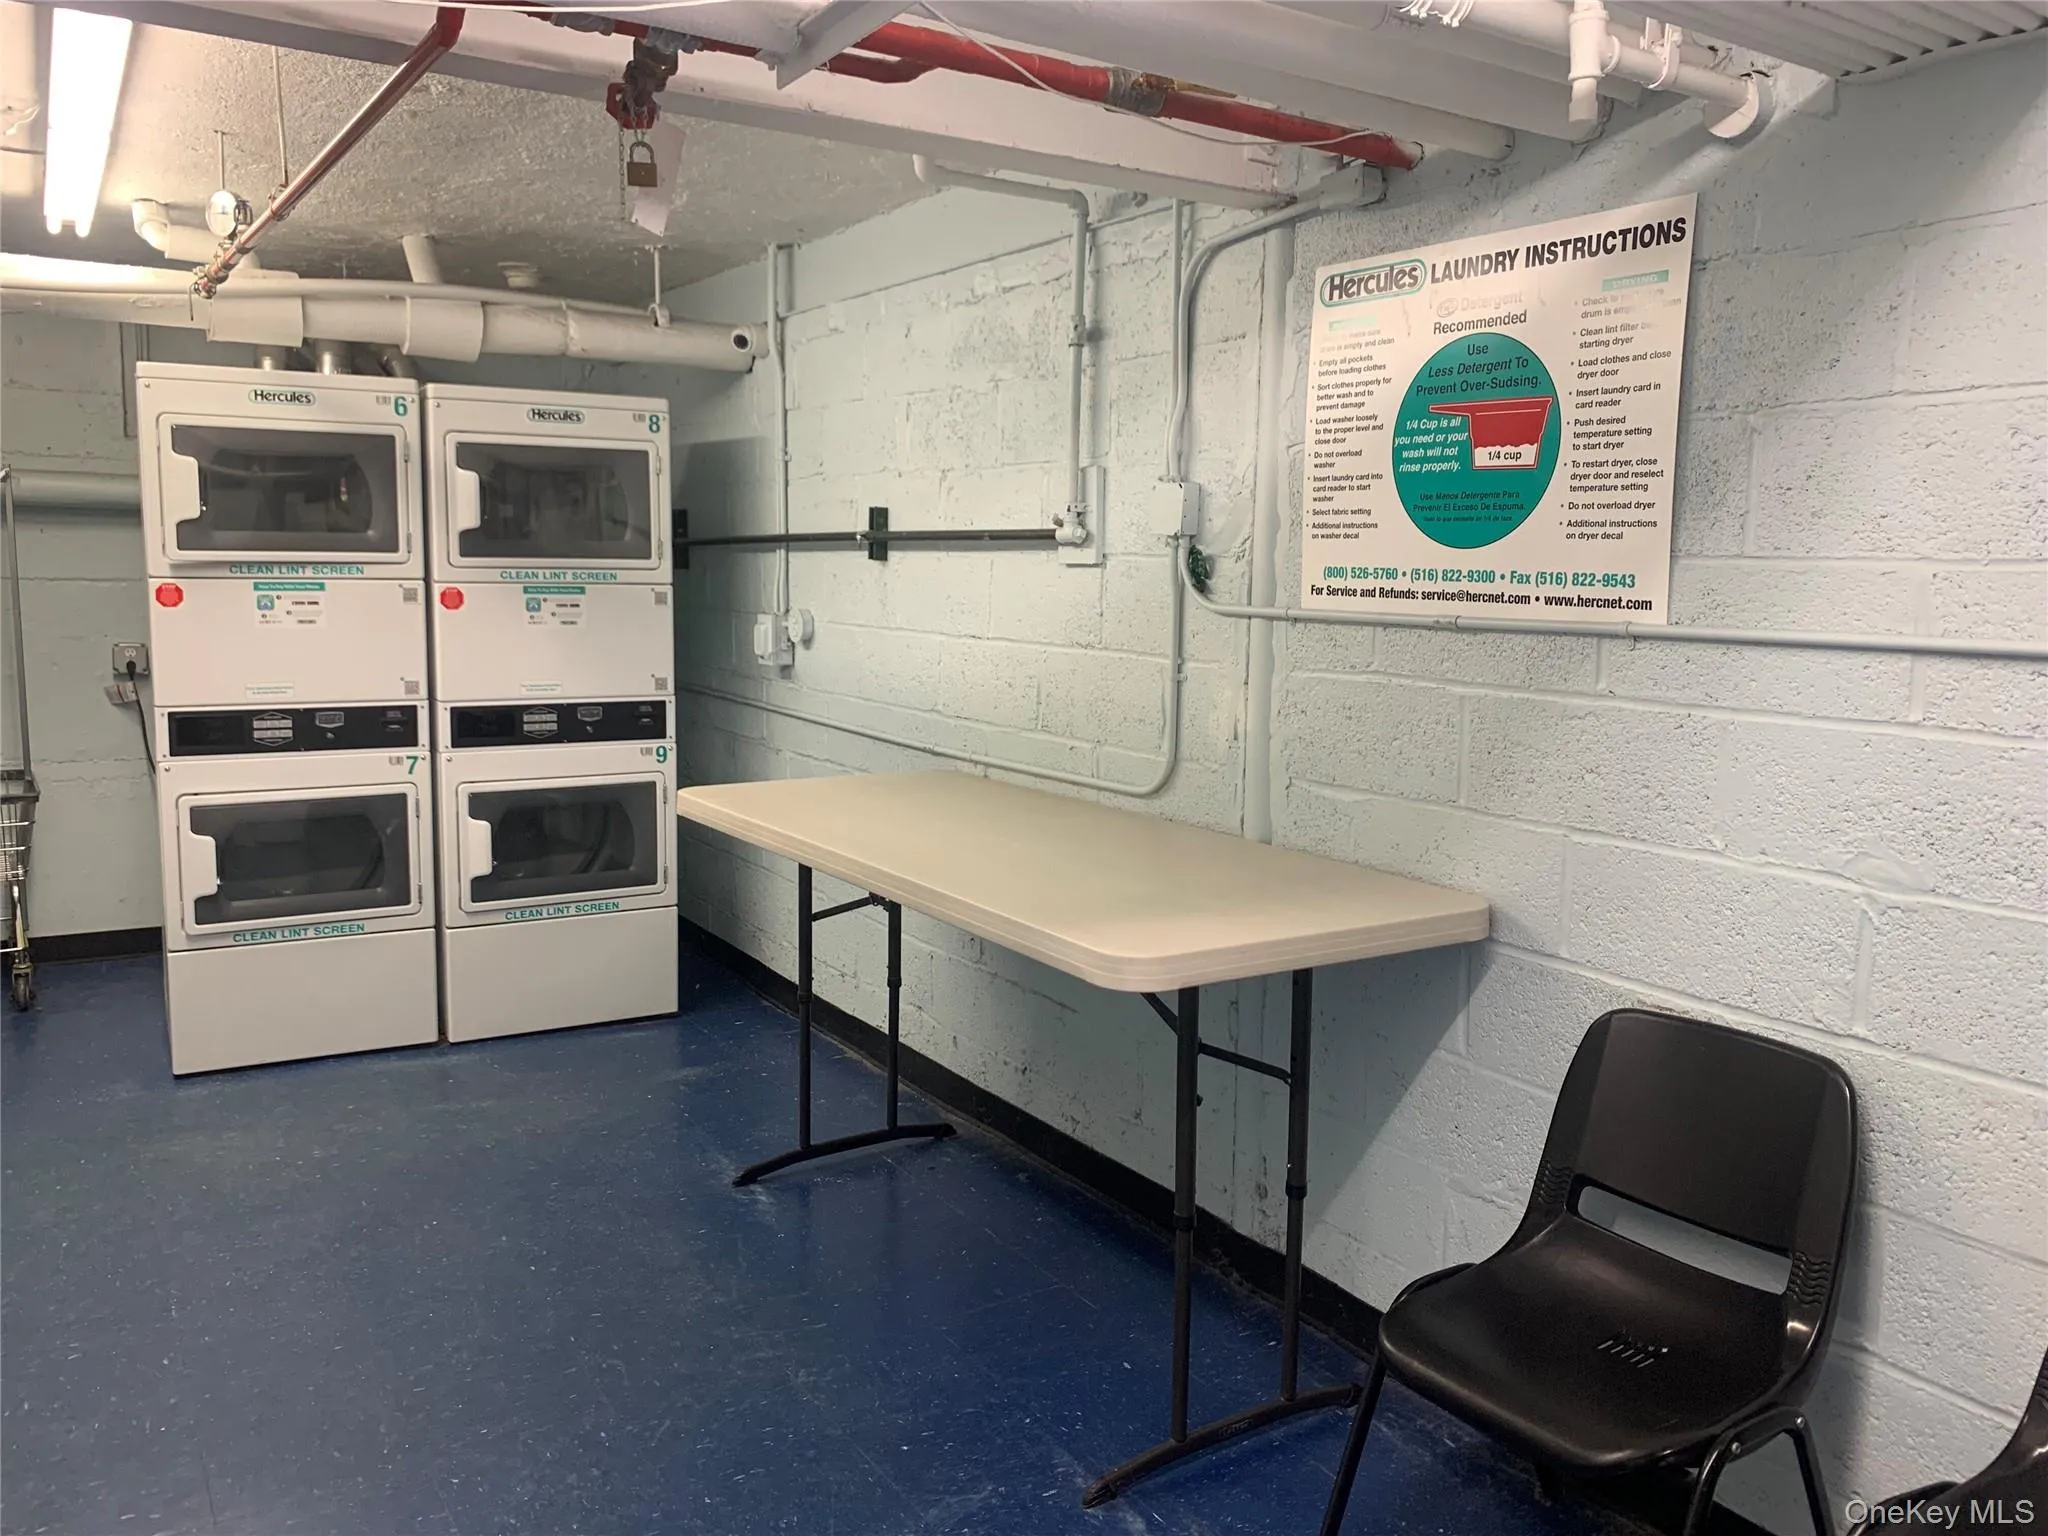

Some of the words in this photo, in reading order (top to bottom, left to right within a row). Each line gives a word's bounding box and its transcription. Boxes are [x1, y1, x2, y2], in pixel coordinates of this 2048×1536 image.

[1329, 264, 1419, 300] Hercules
[1431, 248, 1520, 284] LAUNDRY
[1525, 217, 1686, 268] INSTRUCTIONS
[1461, 292, 1523, 311] Detergent
[1434, 310, 1527, 334] Recommended
[1580, 327, 1603, 336] Clean
[1605, 325, 1618, 334] lint
[1620, 323, 1639, 332] filter
[1378, 337, 1394, 345] clean
[1579, 340, 1610, 349] starting
[1612, 336, 1633, 346] dryer
[1467, 344, 1488, 356] Use
[1348, 355, 1373, 364] pockets
[1578, 358, 1598, 367] Load
[1601, 356, 1630, 365] clothes
[1632, 352, 1647, 361] and
[1650, 350, 1671, 359] close
[1429, 366, 1453, 378] Less
[1457, 359, 1512, 374] Detergent
[1515, 357, 1528, 368] To
[1577, 371, 1598, 380] dryer
[1600, 369, 1619, 377] door
[1332, 381, 1354, 389] clothes
[1355, 379, 1381, 389] properly
[1417, 384, 1456, 396] Prevent
[1460, 376, 1541, 392] Over-Sudsing.
[1576, 388, 1599, 397] Insert
[1601, 386, 1631, 395] laundry
[1633, 383, 1651, 392] card
[254, 390, 311, 404] Hercules
[394, 396, 408, 416] 6
[1316, 404, 1338, 412] prevent
[1575, 401, 1593, 409] card
[1595, 399, 1621, 407] reader
[532, 409, 581, 422] Hercules
[1596, 416, 1626, 425] desired
[648, 415, 660, 433] 8
[1407, 421, 1417, 429] 1/4
[1420, 419, 1437, 430] Cup
[1440, 419, 1447, 427] is
[1450, 417, 1461, 427] all
[1395, 437, 1410, 447] you
[1413, 433, 1433, 443] need
[1447, 432, 1468, 444] your
[1573, 429, 1622, 439] temperature
[1624, 427, 1652, 436] setting
[1403, 448, 1424, 458] wash
[1427, 448, 1441, 456] will
[1443, 446, 1458, 456] not
[1603, 441, 1624, 450] dryer
[1488, 452, 1500, 460] 1/4
[1504, 452, 1521, 462] cup
[1572, 460, 1580, 468] To
[1583, 460, 1609, 468] restart
[1611, 459, 1633, 468] dryer,
[1399, 462, 1420, 472] rinse
[1422, 460, 1461, 473] properly.
[1571, 473, 1591, 481] dryer
[1614, 471, 1629, 479] and
[1631, 470, 1663, 478] reselect
[1570, 484, 1618, 493] temperature
[1621, 483, 1648, 492] setting
[1568, 502, 1579, 510] Do
[1597, 501, 1632, 509] overload
[1634, 501, 1655, 510] dryer
[1578, 532, 1599, 541] dryer
[1601, 532, 1623, 540] decal
[229, 565, 273, 575] CLEAN
[279, 565, 308, 574] LINT
[312, 565, 364, 575] SCREEN
[500, 571, 539, 580] CLEAN
[543, 571, 567, 580] LINT
[572, 572, 618, 581] SCREEN
[1324, 566, 1347, 581] (800)
[1351, 567, 1398, 580] 526-5760
[1411, 568, 1438, 583] (516)
[1442, 569, 1495, 584] 822-9300
[1510, 570, 1531, 584] Fax
[1535, 572, 1567, 589] (516)
[1572, 573, 1636, 588] 822-9543
[1311, 585, 1324, 595] For
[1326, 586, 1357, 597] Service
[1360, 587, 1376, 597] and
[1379, 587, 1418, 599] Refunds:
[1421, 589, 1530, 605] service@hercnet.com
[1544, 595, 1652, 611] www.hercnet.com
[656, 746, 667, 763] 9
[406, 756, 418, 774] 7
[505, 909, 543, 920] CLEAN
[547, 906, 572, 915] LINT
[575, 902, 619, 912] SCREEN
[233, 932, 276, 942] CLEAN
[282, 928, 309, 939] LINT
[314, 924, 365, 936] SCREEN
